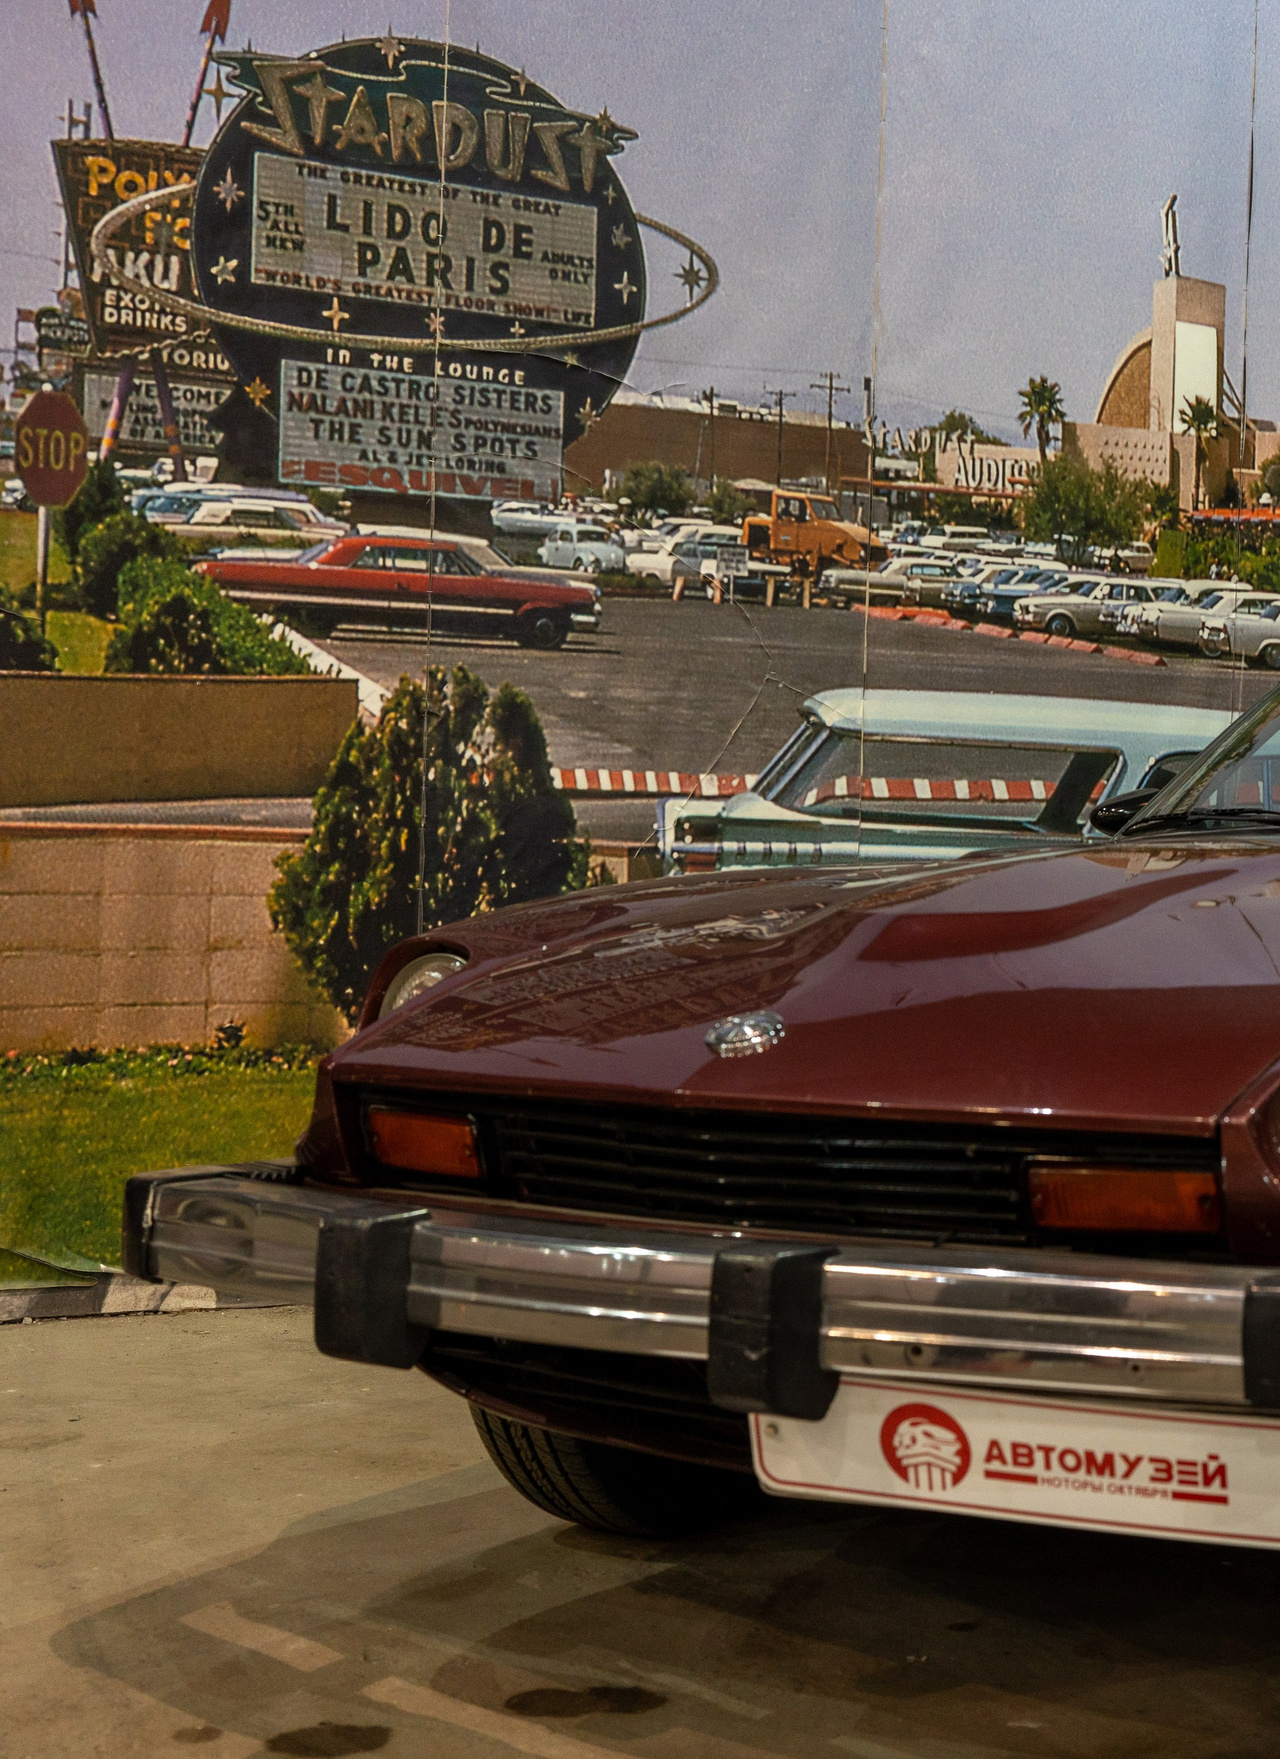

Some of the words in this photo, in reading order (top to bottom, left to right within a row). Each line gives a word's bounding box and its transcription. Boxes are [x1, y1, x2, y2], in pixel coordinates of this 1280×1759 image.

[241, 60, 614, 194] STARDUST
[295, 163, 328, 180] THE
[340, 171, 428, 196] GREATEST
[439, 184, 460, 200] OF
[470, 190, 502, 207] THE
[511, 198, 562, 217] GREAT
[257, 200, 295, 221] 5TH
[269, 219, 304, 236] ALL
[326, 193, 448, 248] LIDO
[482, 217, 534, 260] DE
[265, 234, 305, 251] NEW
[541, 250, 594, 270] ADULTS
[357, 241, 510, 295] PARIS
[549, 269, 591, 285] ONLY
[351, 281, 434, 304] GREATEST
[445, 293, 495, 313] FLOOR
[104, 307, 188, 333] DRINKS
[370, 352, 414, 373] THE
[297, 366, 329, 390] DE
[341, 371, 439, 402] CASTRO
[452, 384, 553, 415] SISTERS
[287, 390, 375, 420] NALANI
[464, 417, 562, 440] POLYNESIANS
[19, 427, 84, 470] STOP
[310, 417, 363, 445] THE
[377, 425, 432, 450] SUN
[452, 432, 538, 458] SPOTS
[862, 416, 976, 456] STARDUST
[359, 448, 381, 464] AL
[387, 451, 398, 464] &
[446, 457, 507, 474] LORING
[984, 1439, 1228, 1490] АВТОМУЗЕЙ
[1040, 1476, 1104, 1494] МОТОРЫ
[1106, 1481, 1170, 1499] ОКТЯБРЯ
